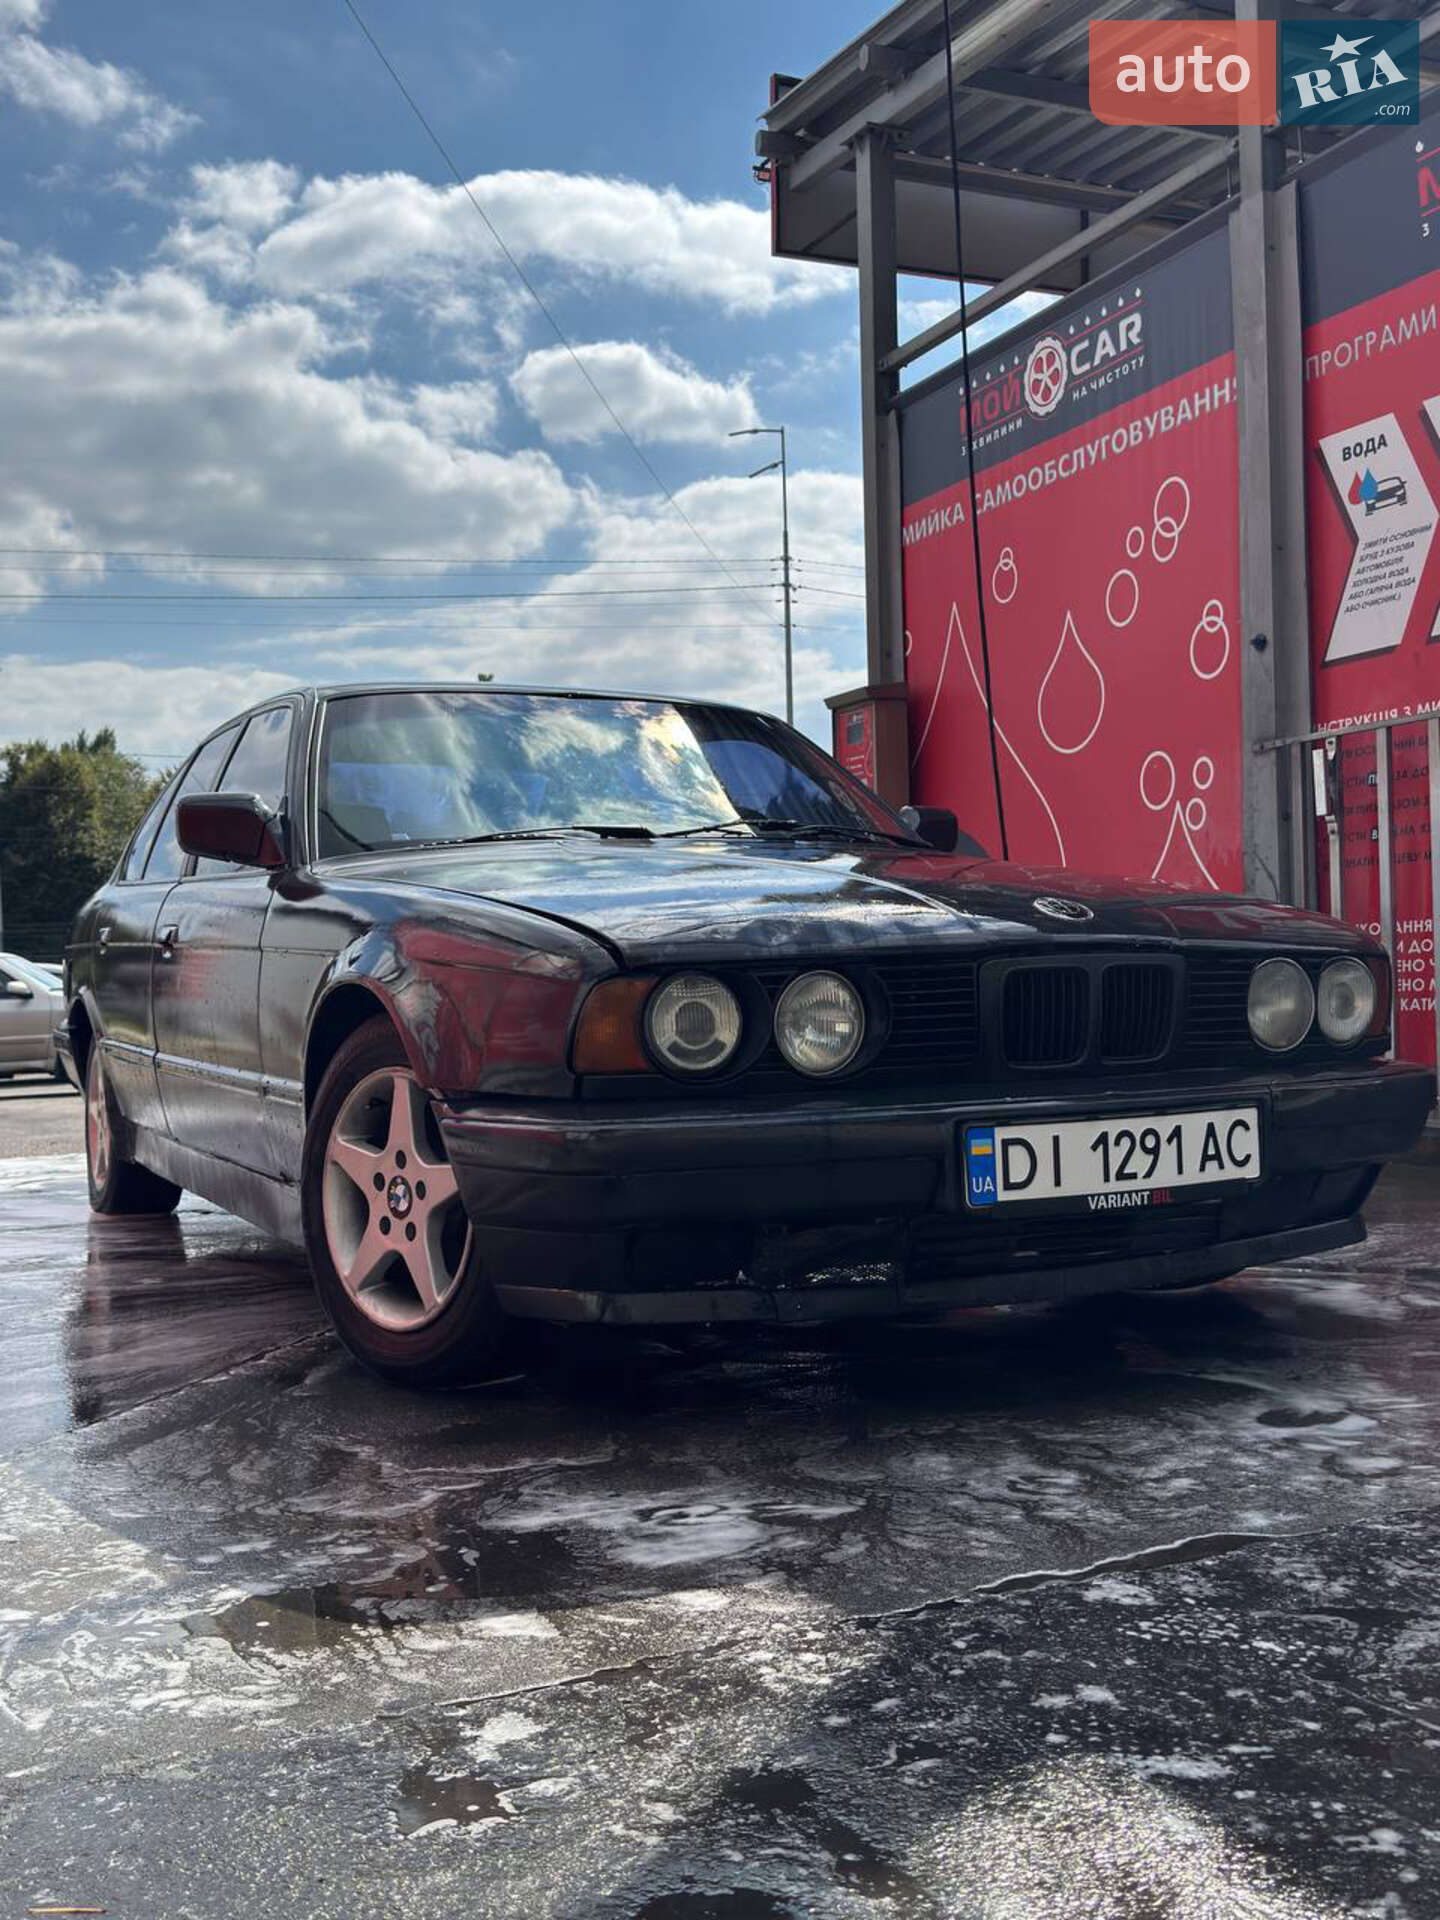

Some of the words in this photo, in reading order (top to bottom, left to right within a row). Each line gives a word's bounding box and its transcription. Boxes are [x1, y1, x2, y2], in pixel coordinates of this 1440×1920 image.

[1070, 312, 1142, 376] CAR
[1305, 303, 1437, 382] ПРОГРАМИ
[1073, 386, 1088, 402] НА
[1090, 354, 1145, 391] ЧИСТОТУ
[1341, 433, 1388, 462] ВОДА
[902, 502, 965, 546] МИЙКА
[1000, 1136, 1062, 1192] DI
[1090, 1124, 1183, 1184] 1291
[1199, 1118, 1252, 1173] AC
[972, 1176, 994, 1193] UA
[1088, 1190, 1150, 1210] VARIANT
